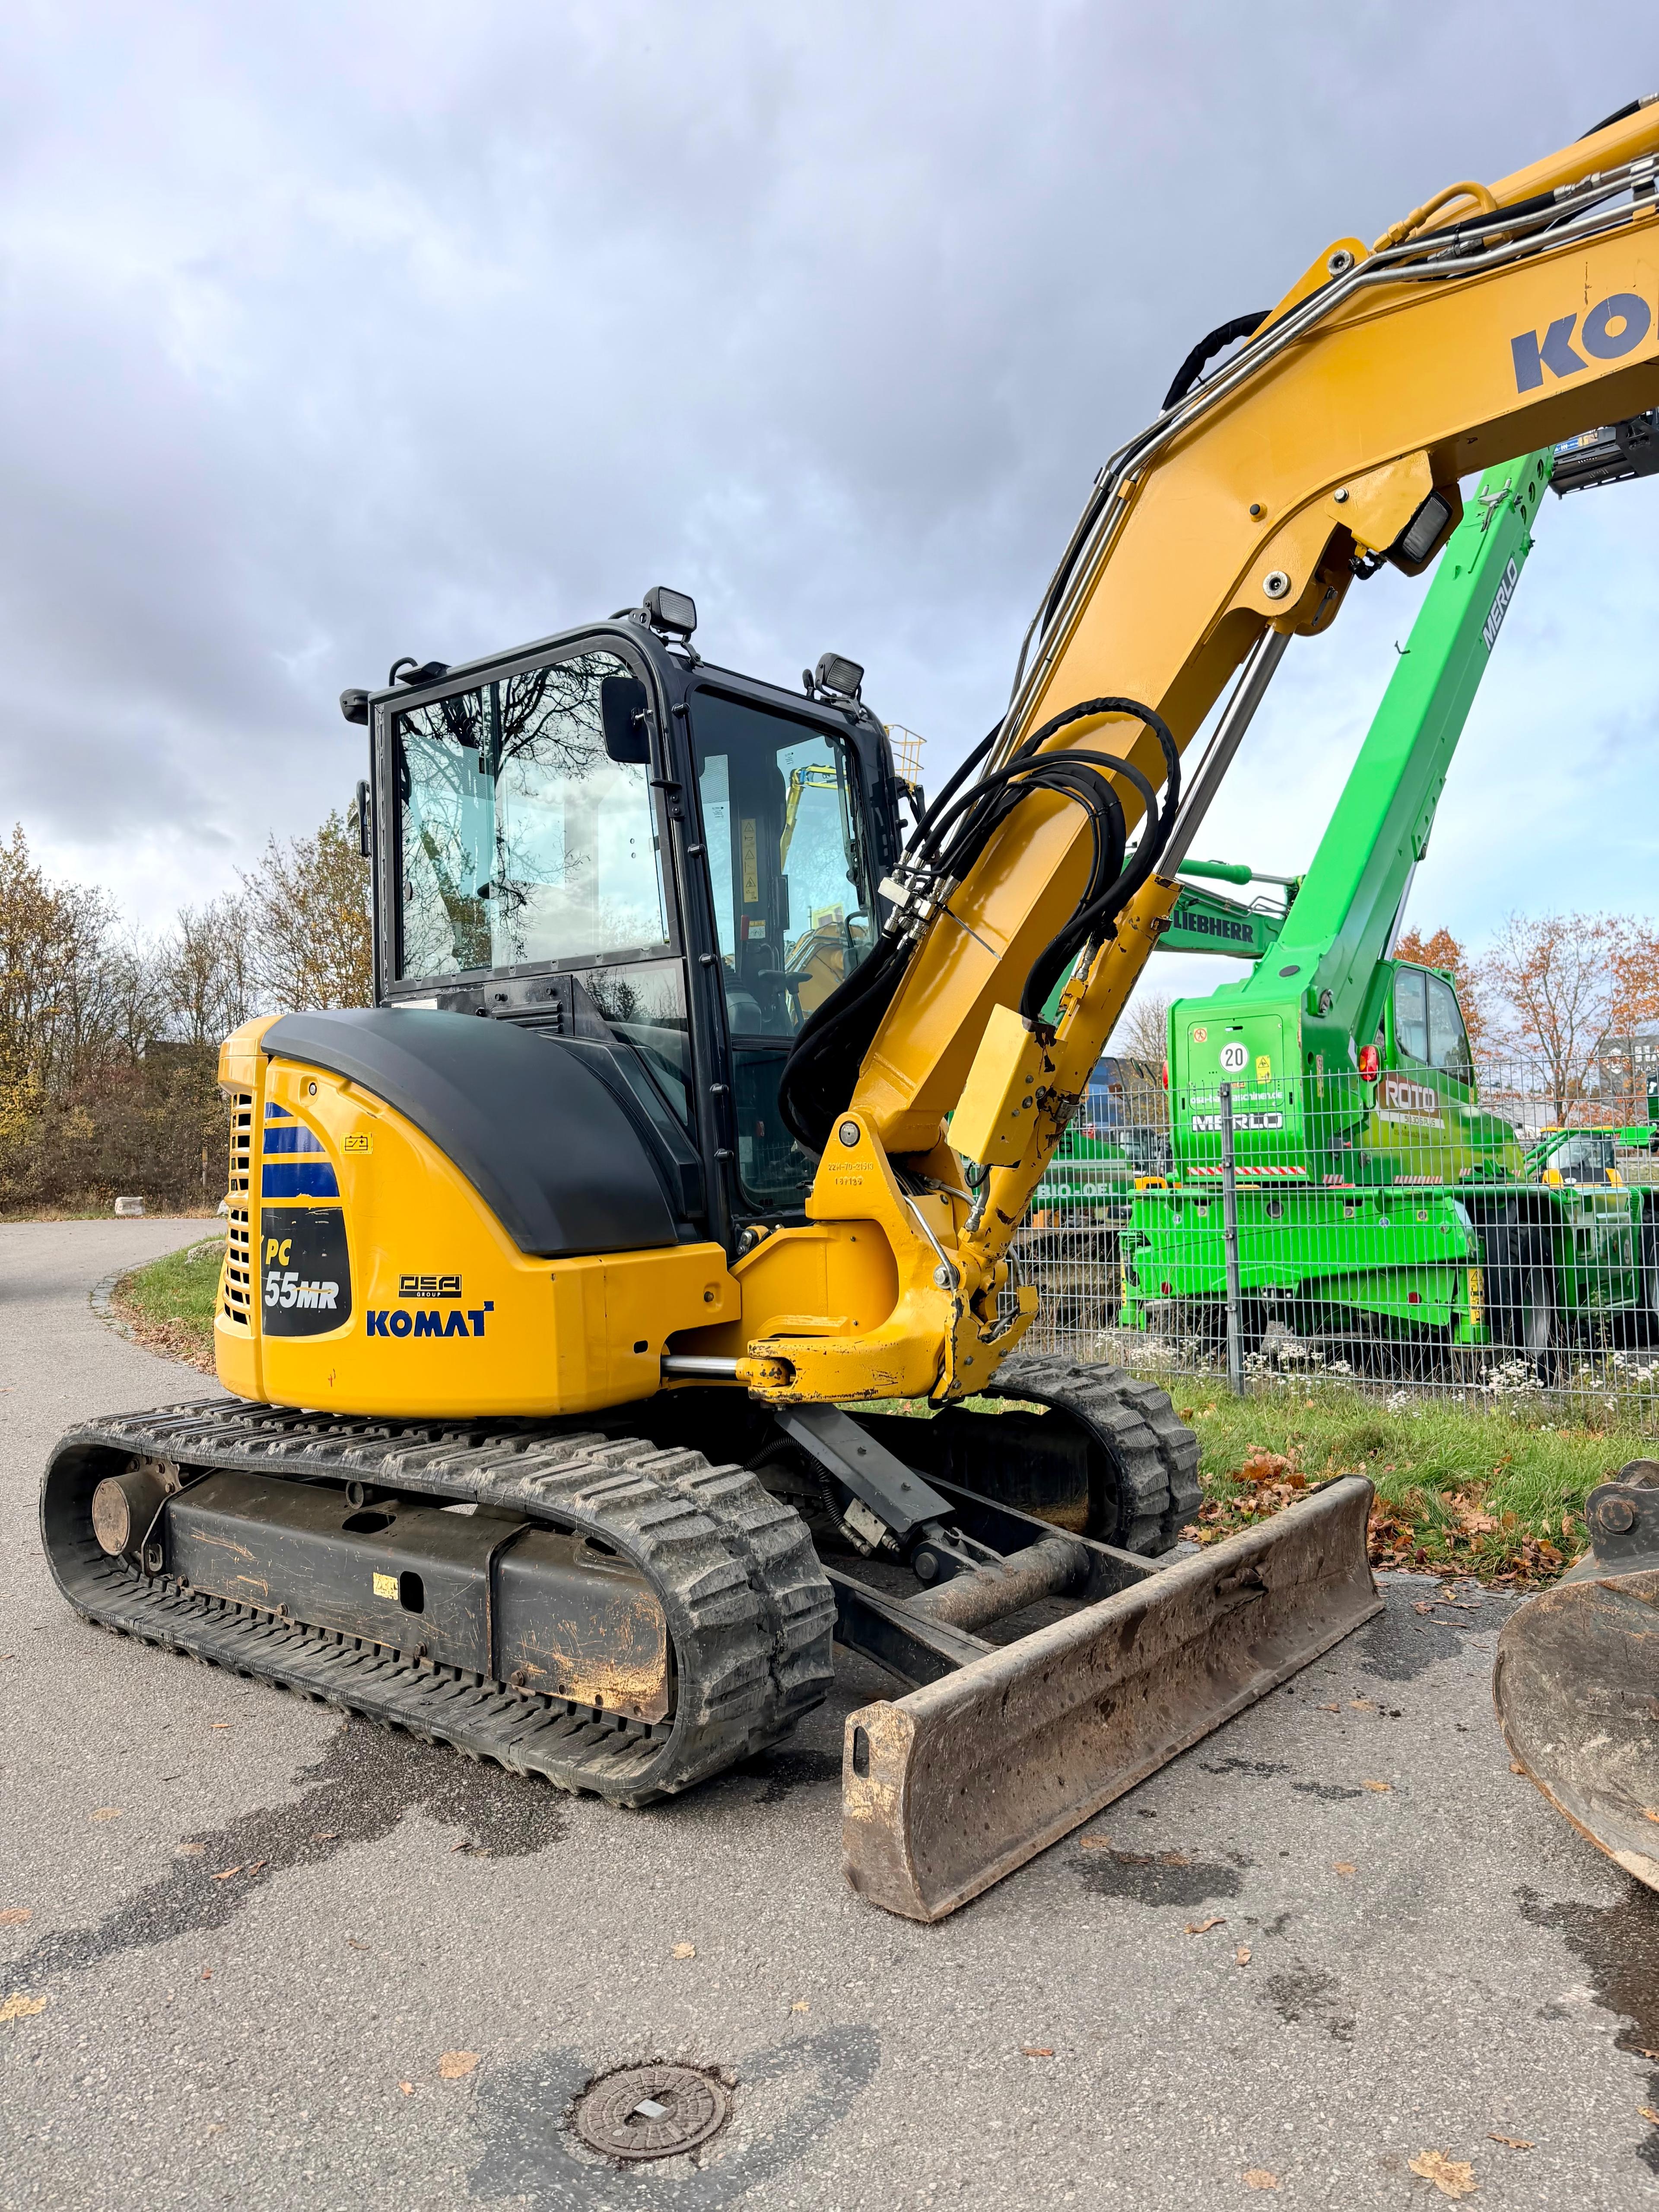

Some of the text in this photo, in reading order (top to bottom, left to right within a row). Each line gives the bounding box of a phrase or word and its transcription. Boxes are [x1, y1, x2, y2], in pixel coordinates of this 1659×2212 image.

[1510, 292, 1659, 394] KO
[1483, 557, 1518, 651] MERLO
[1173, 909, 1253, 943] LIEBHERR
[1225, 1048, 1243, 1066] 20
[1190, 1090, 1283, 1104] osa-baaschinen.de
[1386, 1080, 1435, 1113] ROTO
[265, 1238, 292, 1266] PC
[264, 1271, 339, 1309] 55MR
[367, 1301, 494, 1337] KOMAT
